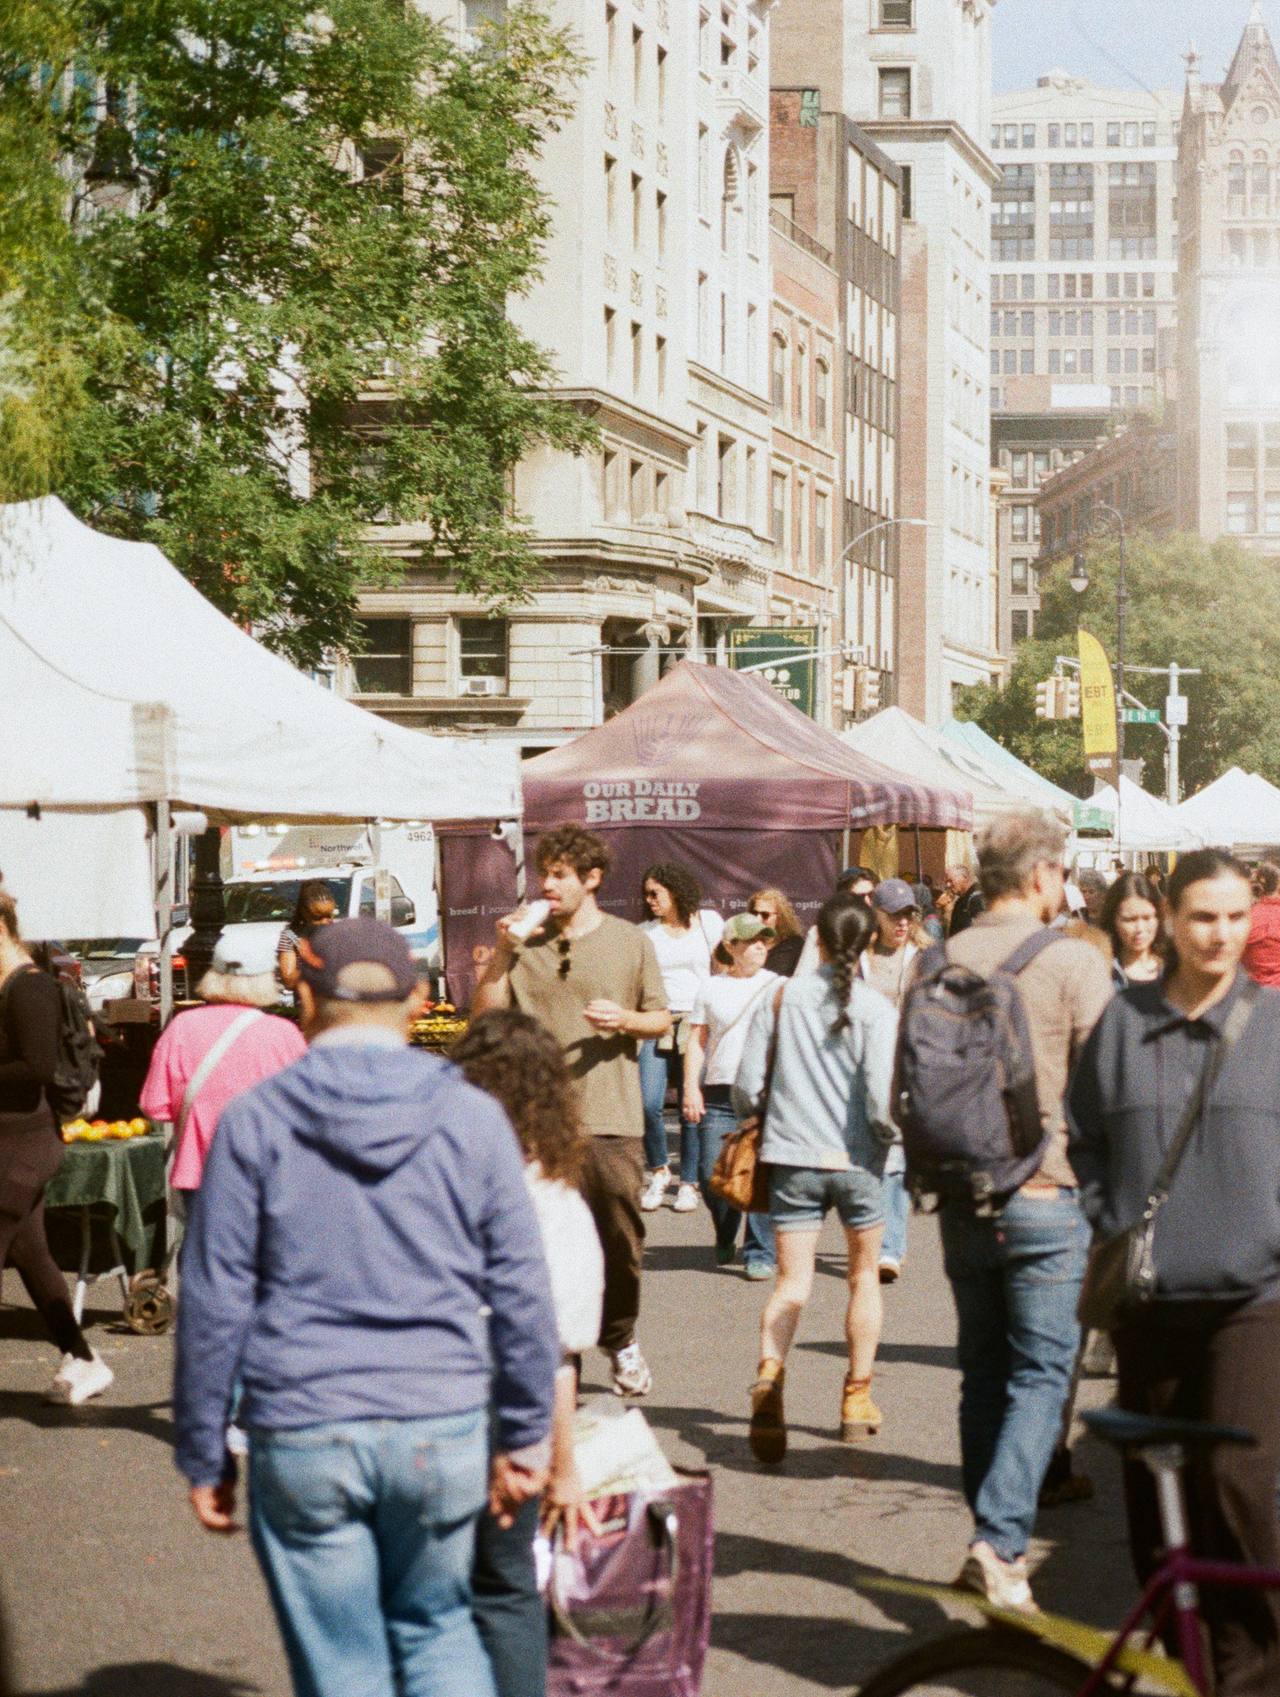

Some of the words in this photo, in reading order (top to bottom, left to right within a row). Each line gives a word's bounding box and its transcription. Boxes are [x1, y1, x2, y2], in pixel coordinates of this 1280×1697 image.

[776, 688, 800, 700] LUB
[1137, 711, 1147, 721] 16
[582, 781, 631, 799] OUR
[584, 797, 702, 824] BREAD
[407, 831, 433, 842] 4962
[320, 843, 364, 853] Northwell
[449, 906, 478, 917] bread
